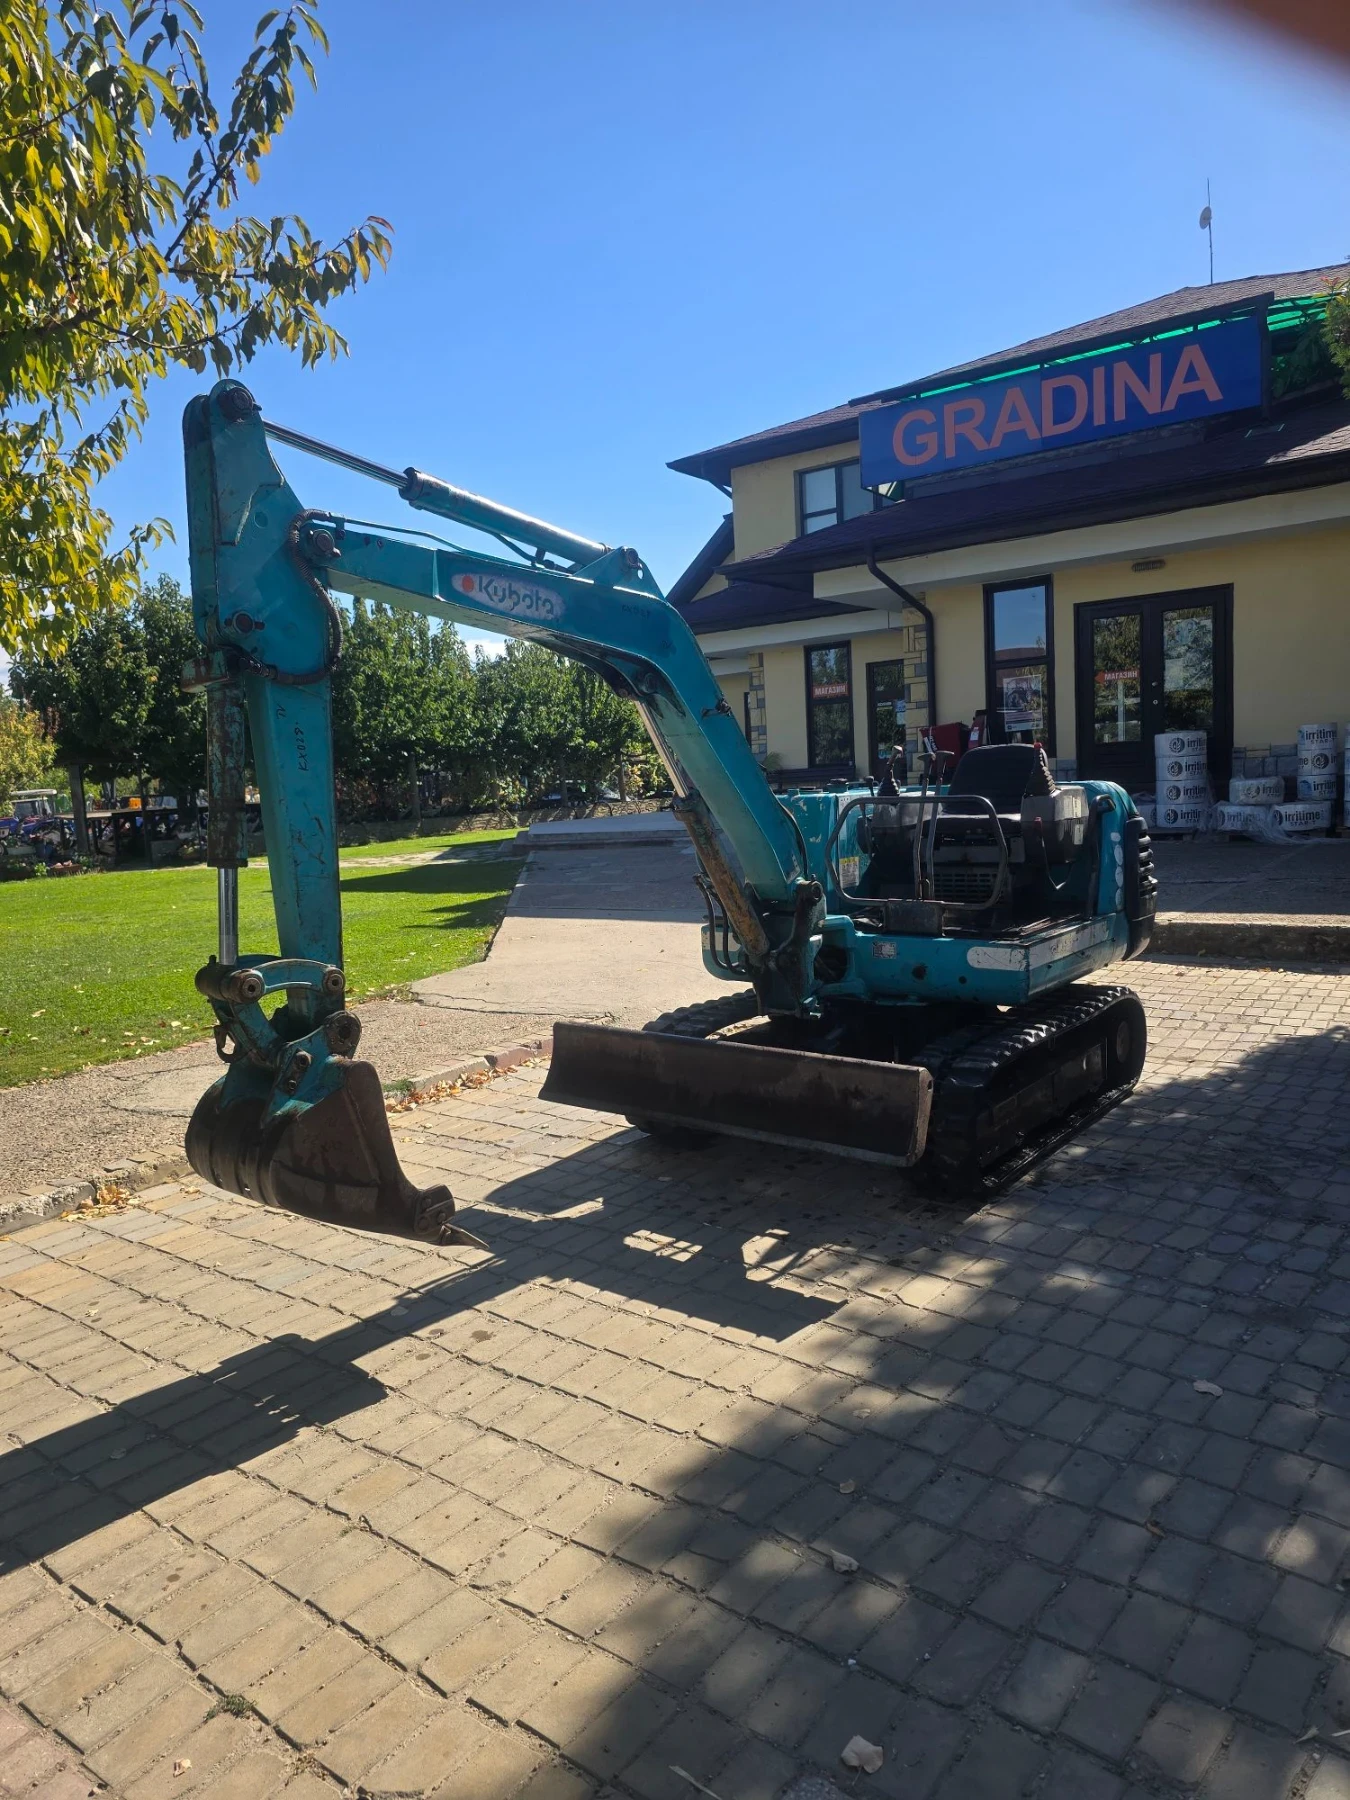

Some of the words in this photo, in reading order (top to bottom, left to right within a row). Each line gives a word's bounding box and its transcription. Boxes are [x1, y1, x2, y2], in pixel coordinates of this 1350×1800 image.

[892, 343, 1224, 467] GRADINA
[478, 575, 555, 616] Kubota
[1104, 670, 1138, 681] МАГАЗИН
[815, 685, 846, 697] МАГАЗИН
[1284, 810, 1321, 822] irritime
